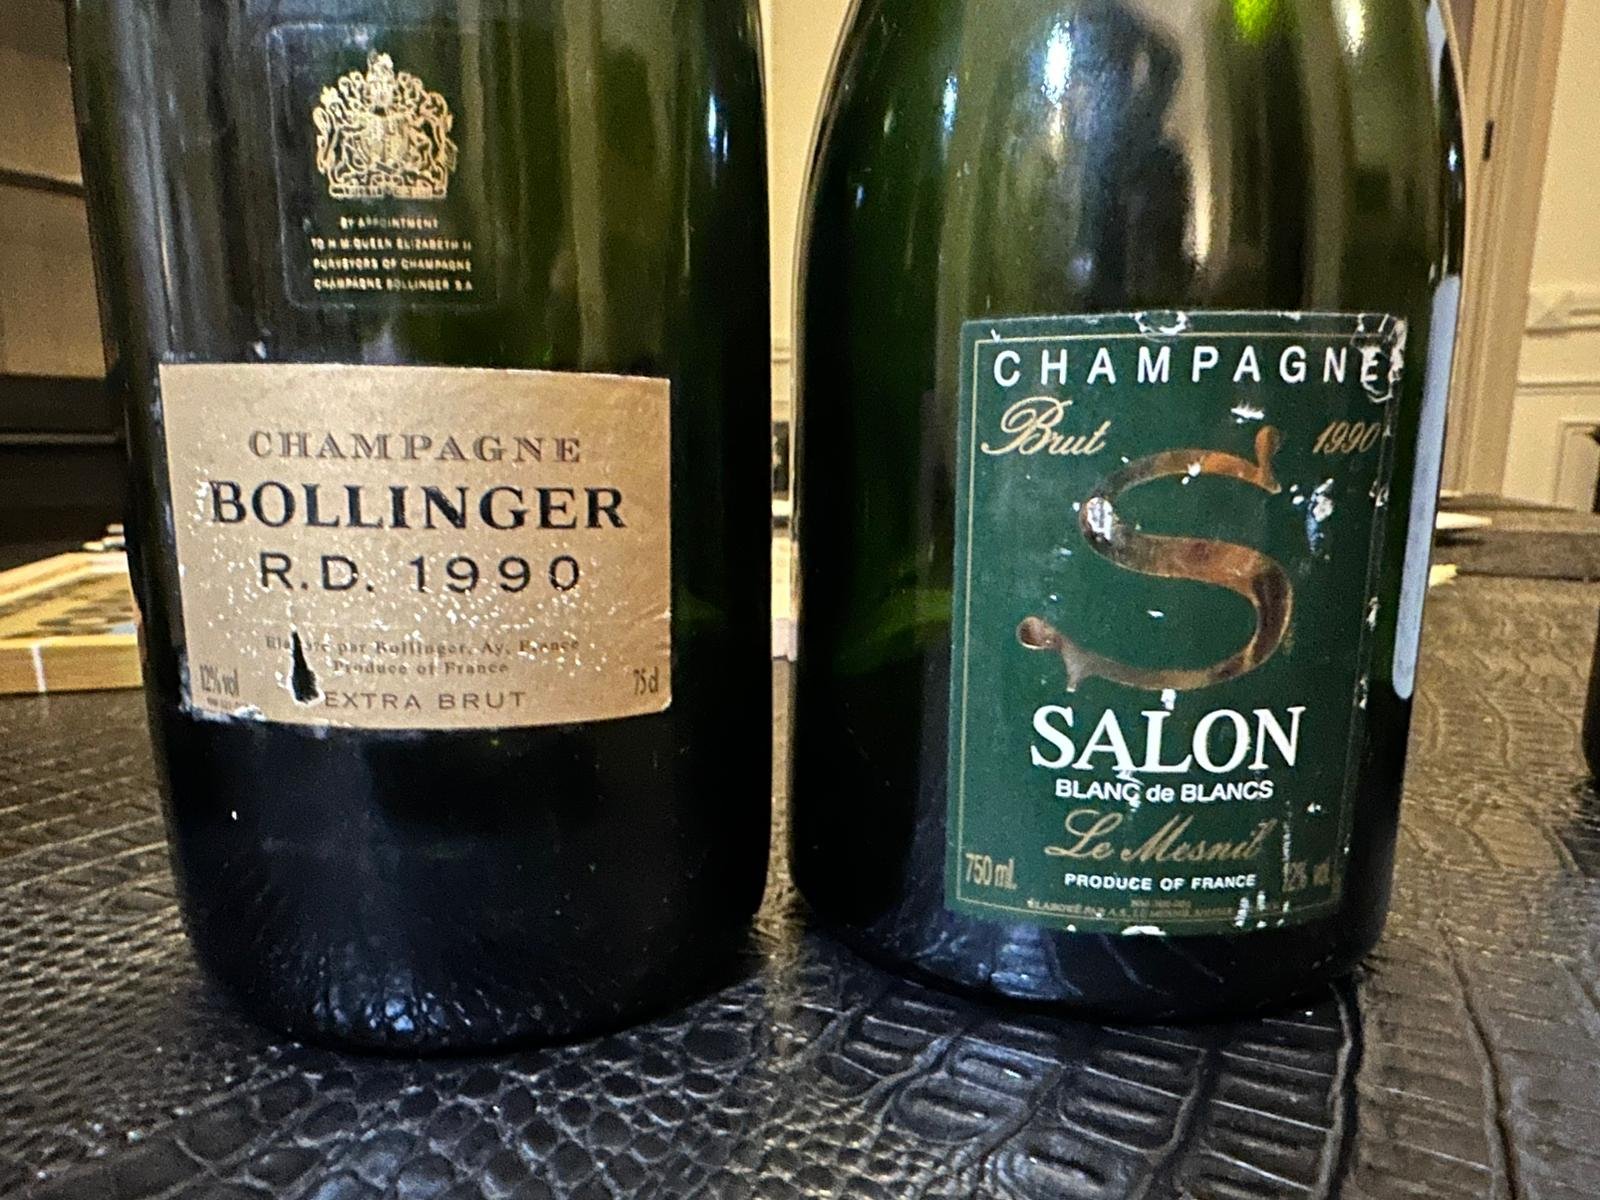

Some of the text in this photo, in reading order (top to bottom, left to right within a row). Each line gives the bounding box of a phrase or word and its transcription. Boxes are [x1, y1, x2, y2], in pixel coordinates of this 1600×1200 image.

[340, 215, 438, 230] BY APPOINTMENT
[310, 237, 325, 251] TO
[396, 238, 459, 251] ELIZABETH
[313, 257, 472, 273] PURVEYORS OF CHAMPAGNE
[314, 277, 383, 291] CHAMPAGNE
[386, 278, 450, 292] BOLLINGER
[994, 345, 1378, 387] CHAMPAGNE
[981, 396, 1380, 457] Brut 1990
[248, 430, 581, 464] CHAMPAGNE
[210, 480, 628, 530] BOLLINGER
[260, 552, 581, 593] R.D. 1990
[338, 641, 366, 655] par
[333, 660, 510, 675] Produce of France
[324, 691, 526, 710] EXTRA BRUT
[1030, 704, 1307, 773] SALON
[1055, 778, 1274, 802] BLANC de BLANCS
[1044, 809, 1123, 860] Le
[965, 853, 992, 886] 750
[1064, 872, 1257, 891] PRODUCE OF FRANCE
